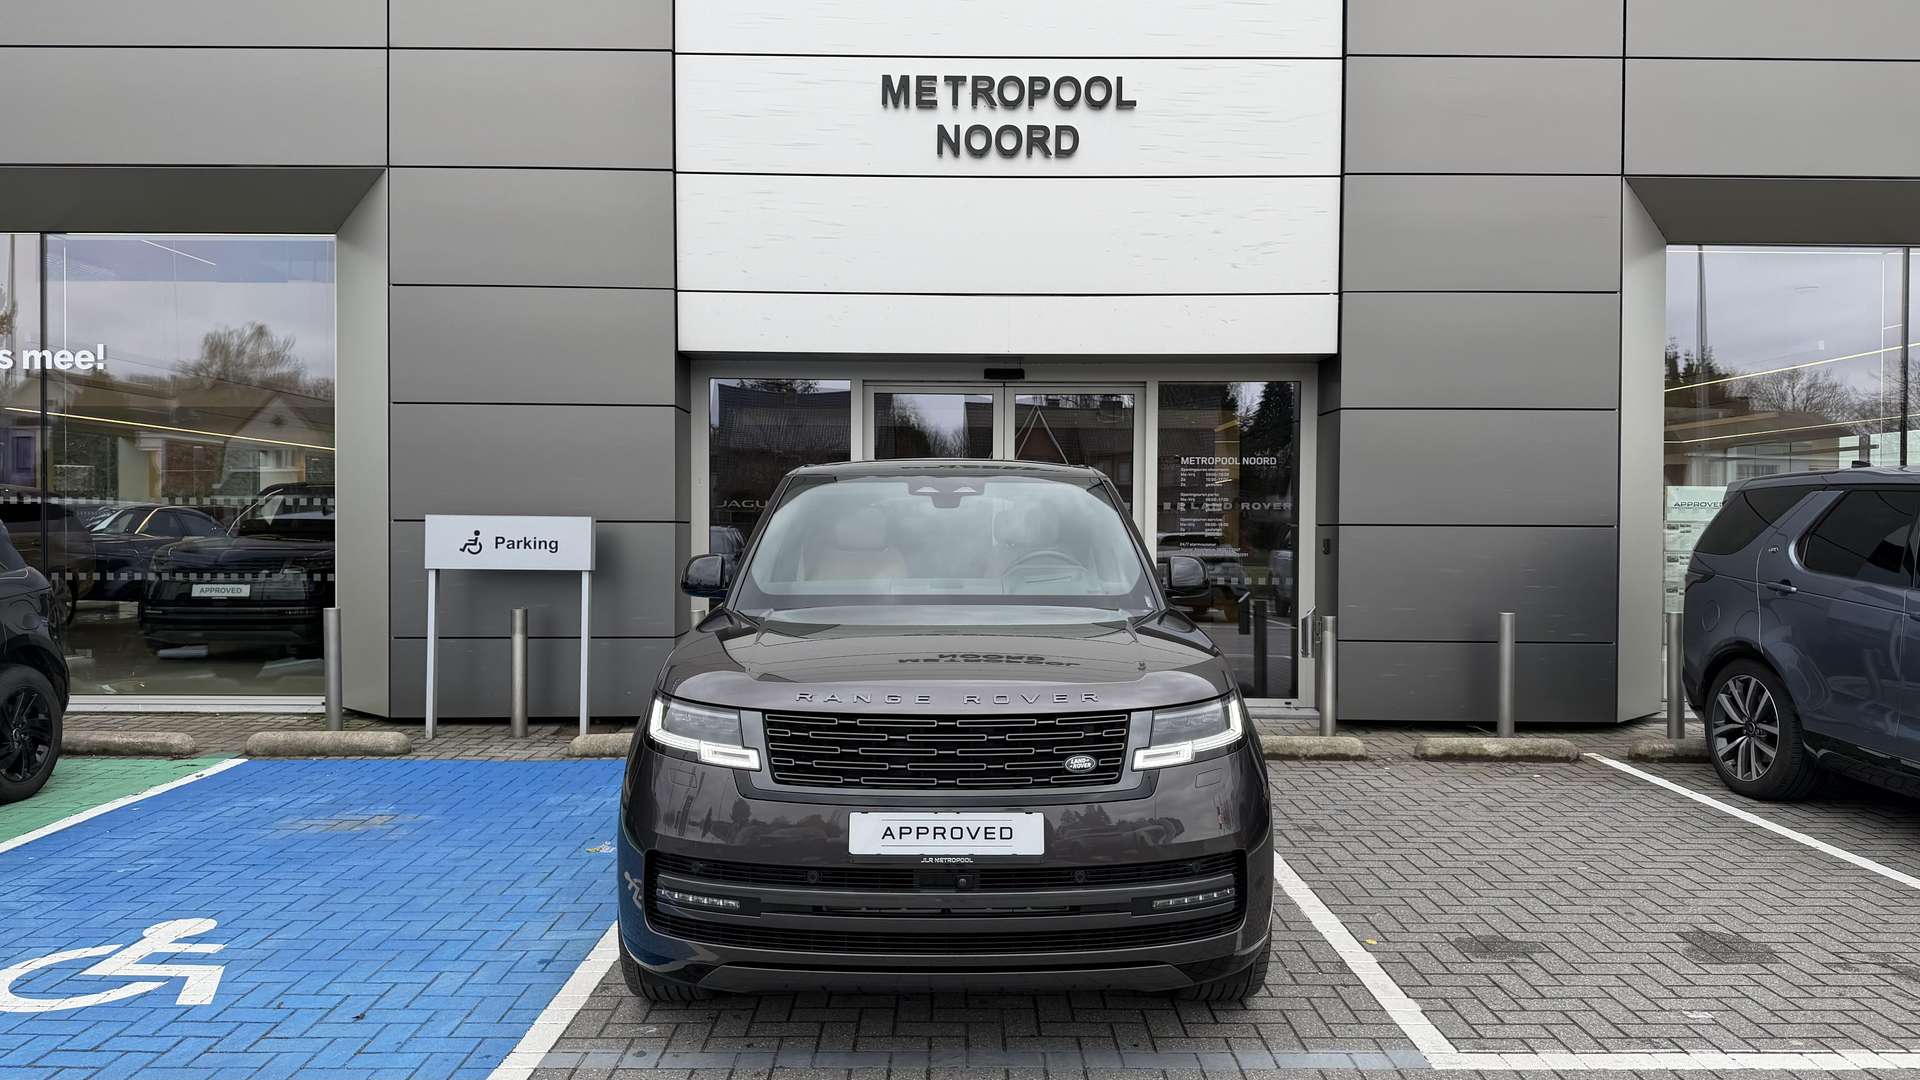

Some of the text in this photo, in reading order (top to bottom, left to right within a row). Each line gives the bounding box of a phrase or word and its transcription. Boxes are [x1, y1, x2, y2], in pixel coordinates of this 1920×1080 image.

[881, 74, 1137, 110] METROPOOL
[936, 124, 1080, 159] NOORD
[22, 343, 105, 370] mee!
[1180, 456, 1277, 465] METROPOOL NOORD
[1241, 502, 1292, 510] ROVER
[494, 535, 559, 554] Parking
[795, 692, 1100, 704] RANGE ROVER
[881, 826, 1013, 840] APPROVED
